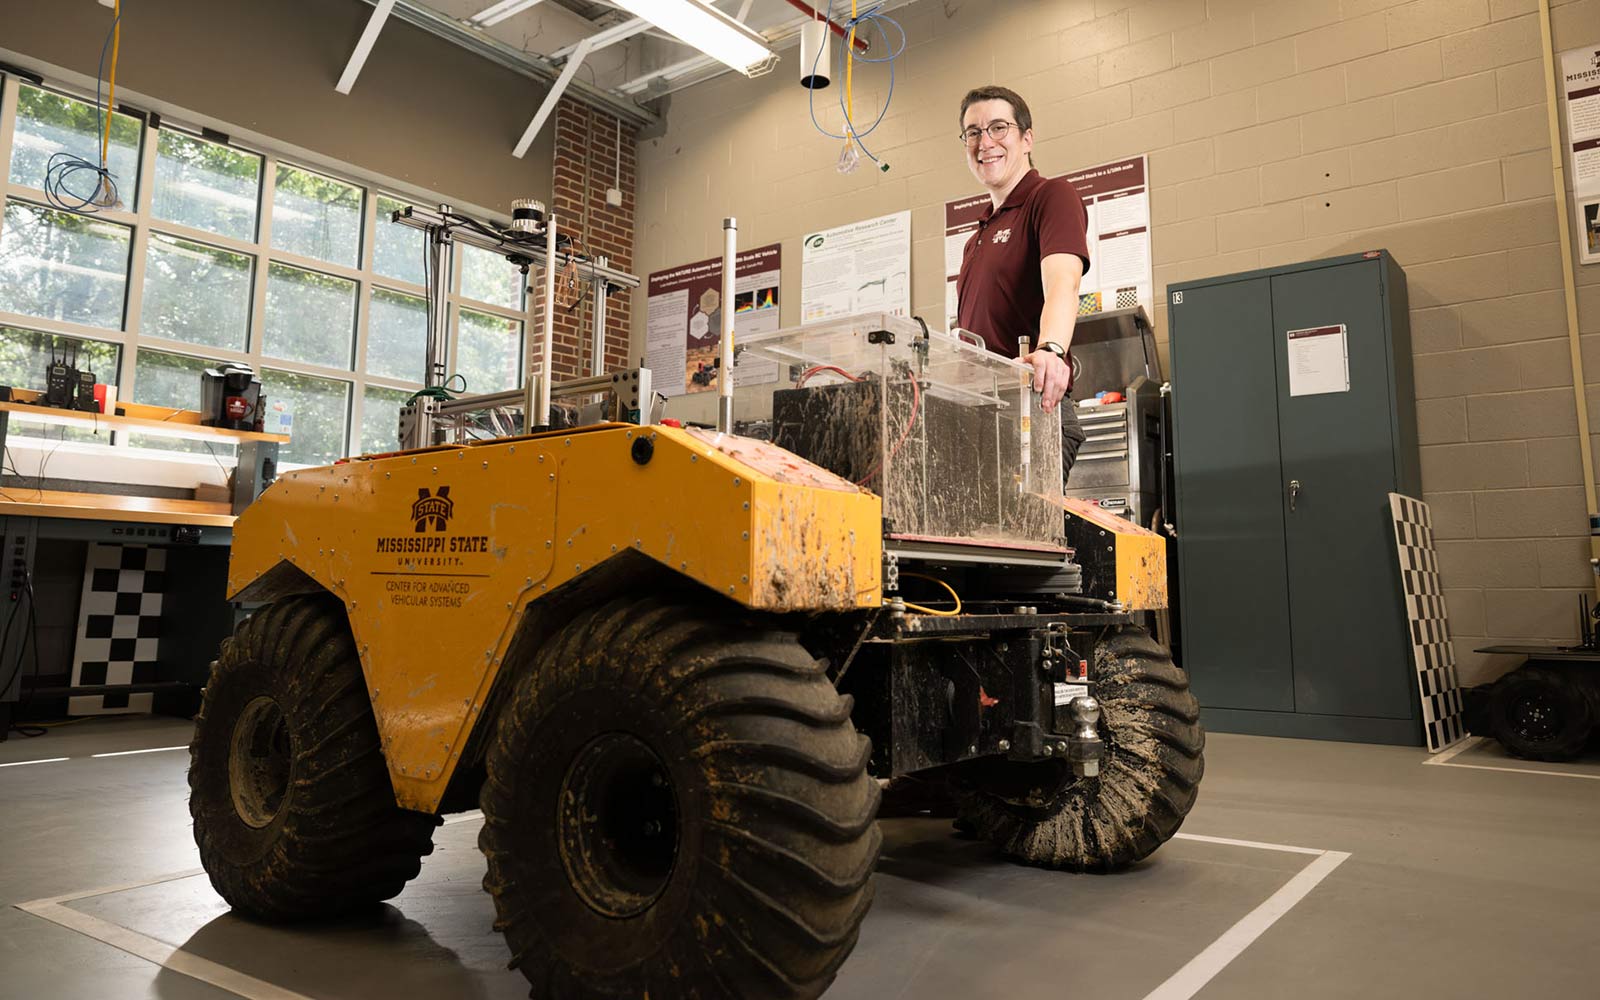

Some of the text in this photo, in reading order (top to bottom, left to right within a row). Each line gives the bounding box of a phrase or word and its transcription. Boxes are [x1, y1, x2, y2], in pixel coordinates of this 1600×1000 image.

[1173, 292, 1182, 304] 13
[417, 500, 448, 517] STATE
[377, 536, 488, 553] MISSISSIPPI STATE
[385, 580, 470, 594] CENTER FOR ADVANCED
[390, 594, 462, 608] VEHICULAR SYSTEMS
